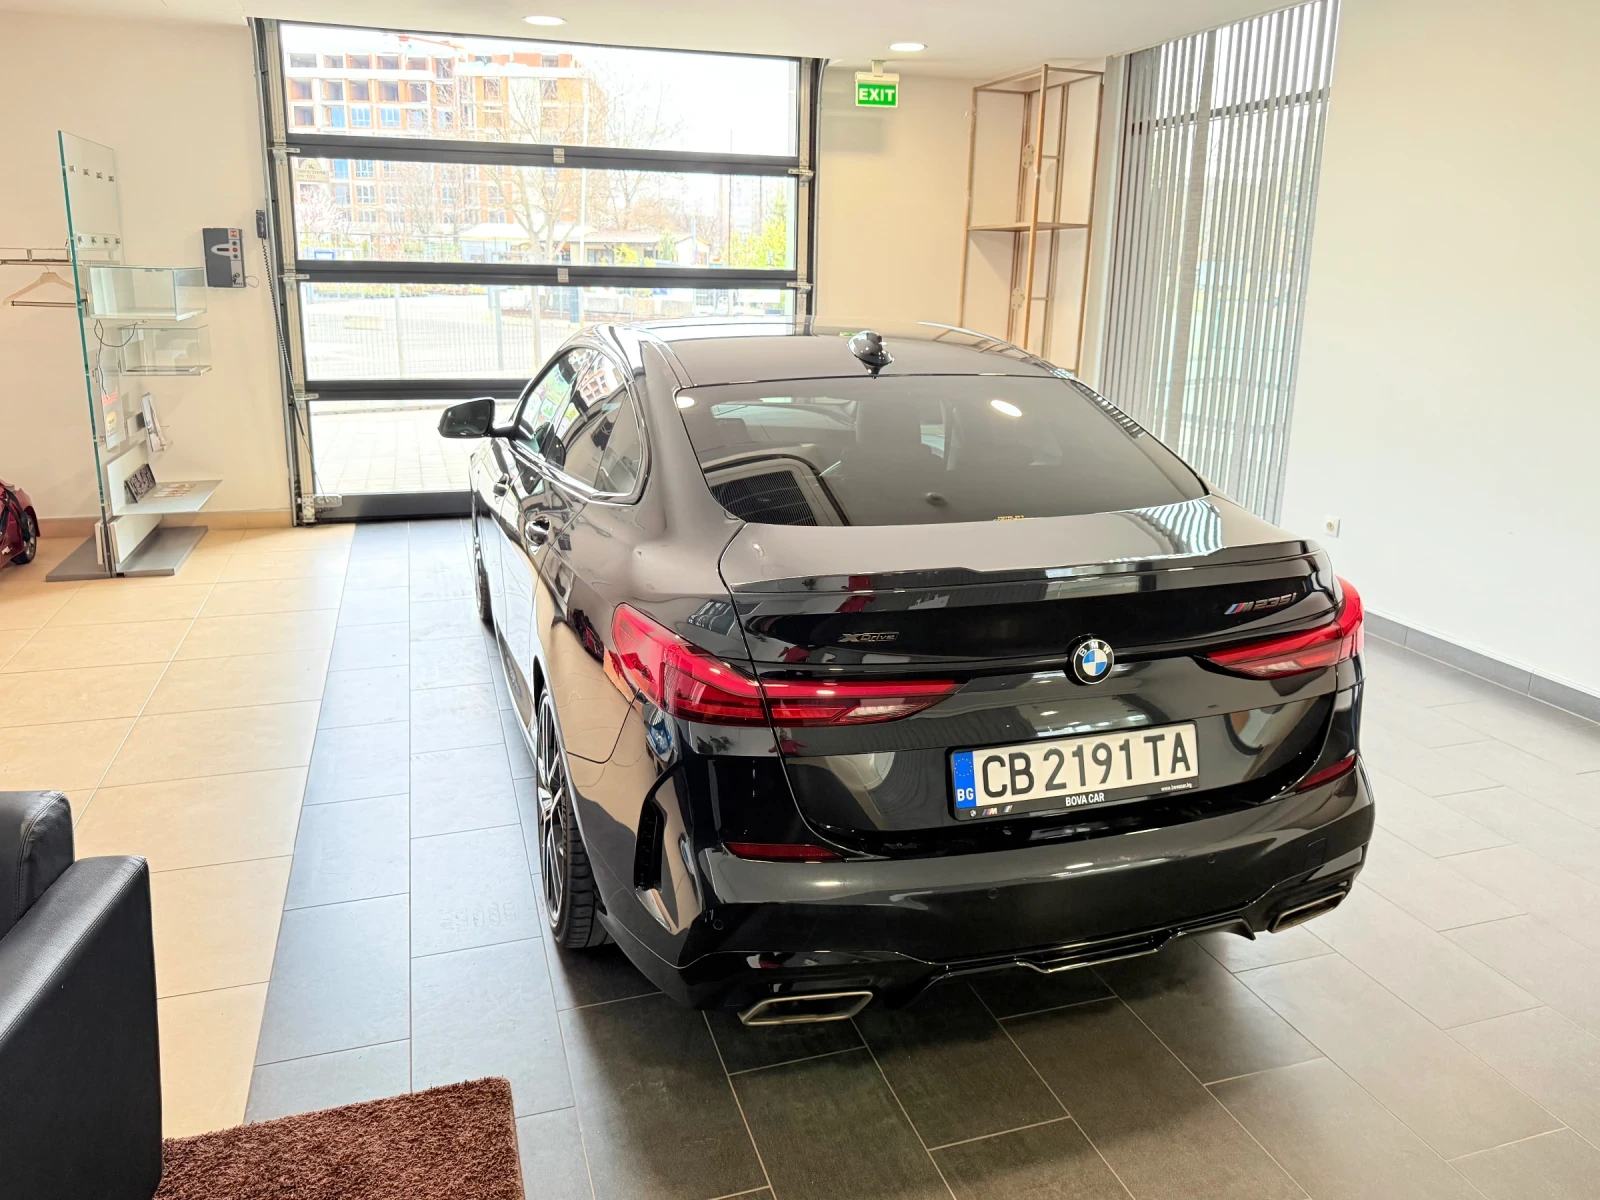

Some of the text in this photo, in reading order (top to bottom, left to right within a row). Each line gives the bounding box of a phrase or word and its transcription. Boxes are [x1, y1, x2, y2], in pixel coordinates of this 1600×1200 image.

[859, 88, 895, 102] EXIT
[982, 732, 1191, 798] CB 2191 TA
[957, 788, 974, 802] BG
[1065, 792, 1105, 807] BOVA CAR
